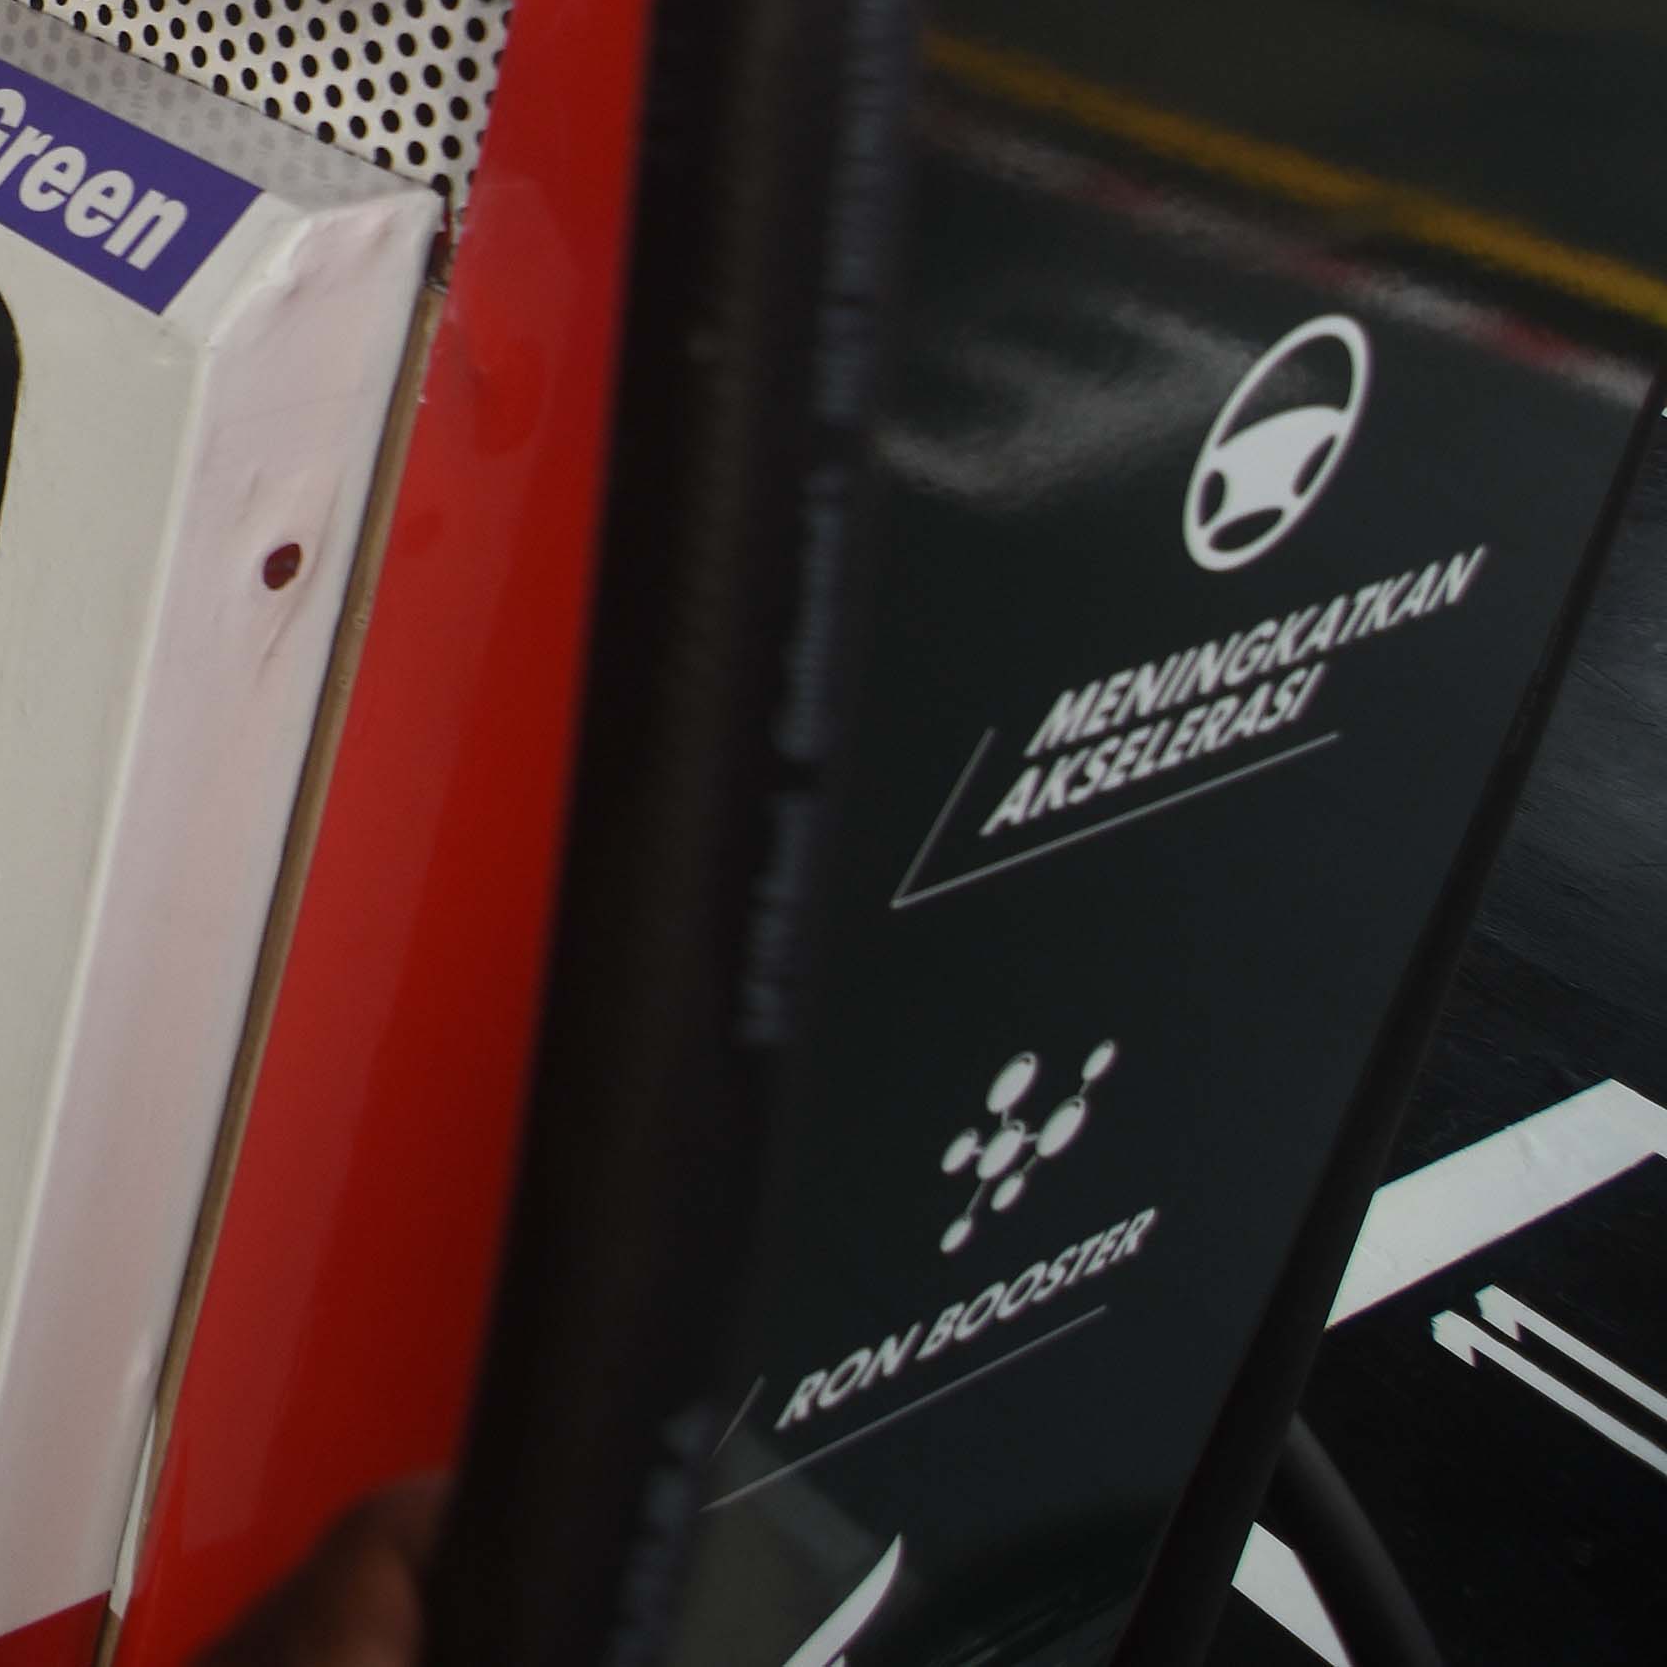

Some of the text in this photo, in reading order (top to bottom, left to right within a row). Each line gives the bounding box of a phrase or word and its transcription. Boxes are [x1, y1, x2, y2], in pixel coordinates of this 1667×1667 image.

[980, 664, 1327, 837] AKSELERASI
[1024, 545, 1486, 760] MENINGKATKAN
[774, 1207, 1157, 1430] RON BOOSTER
